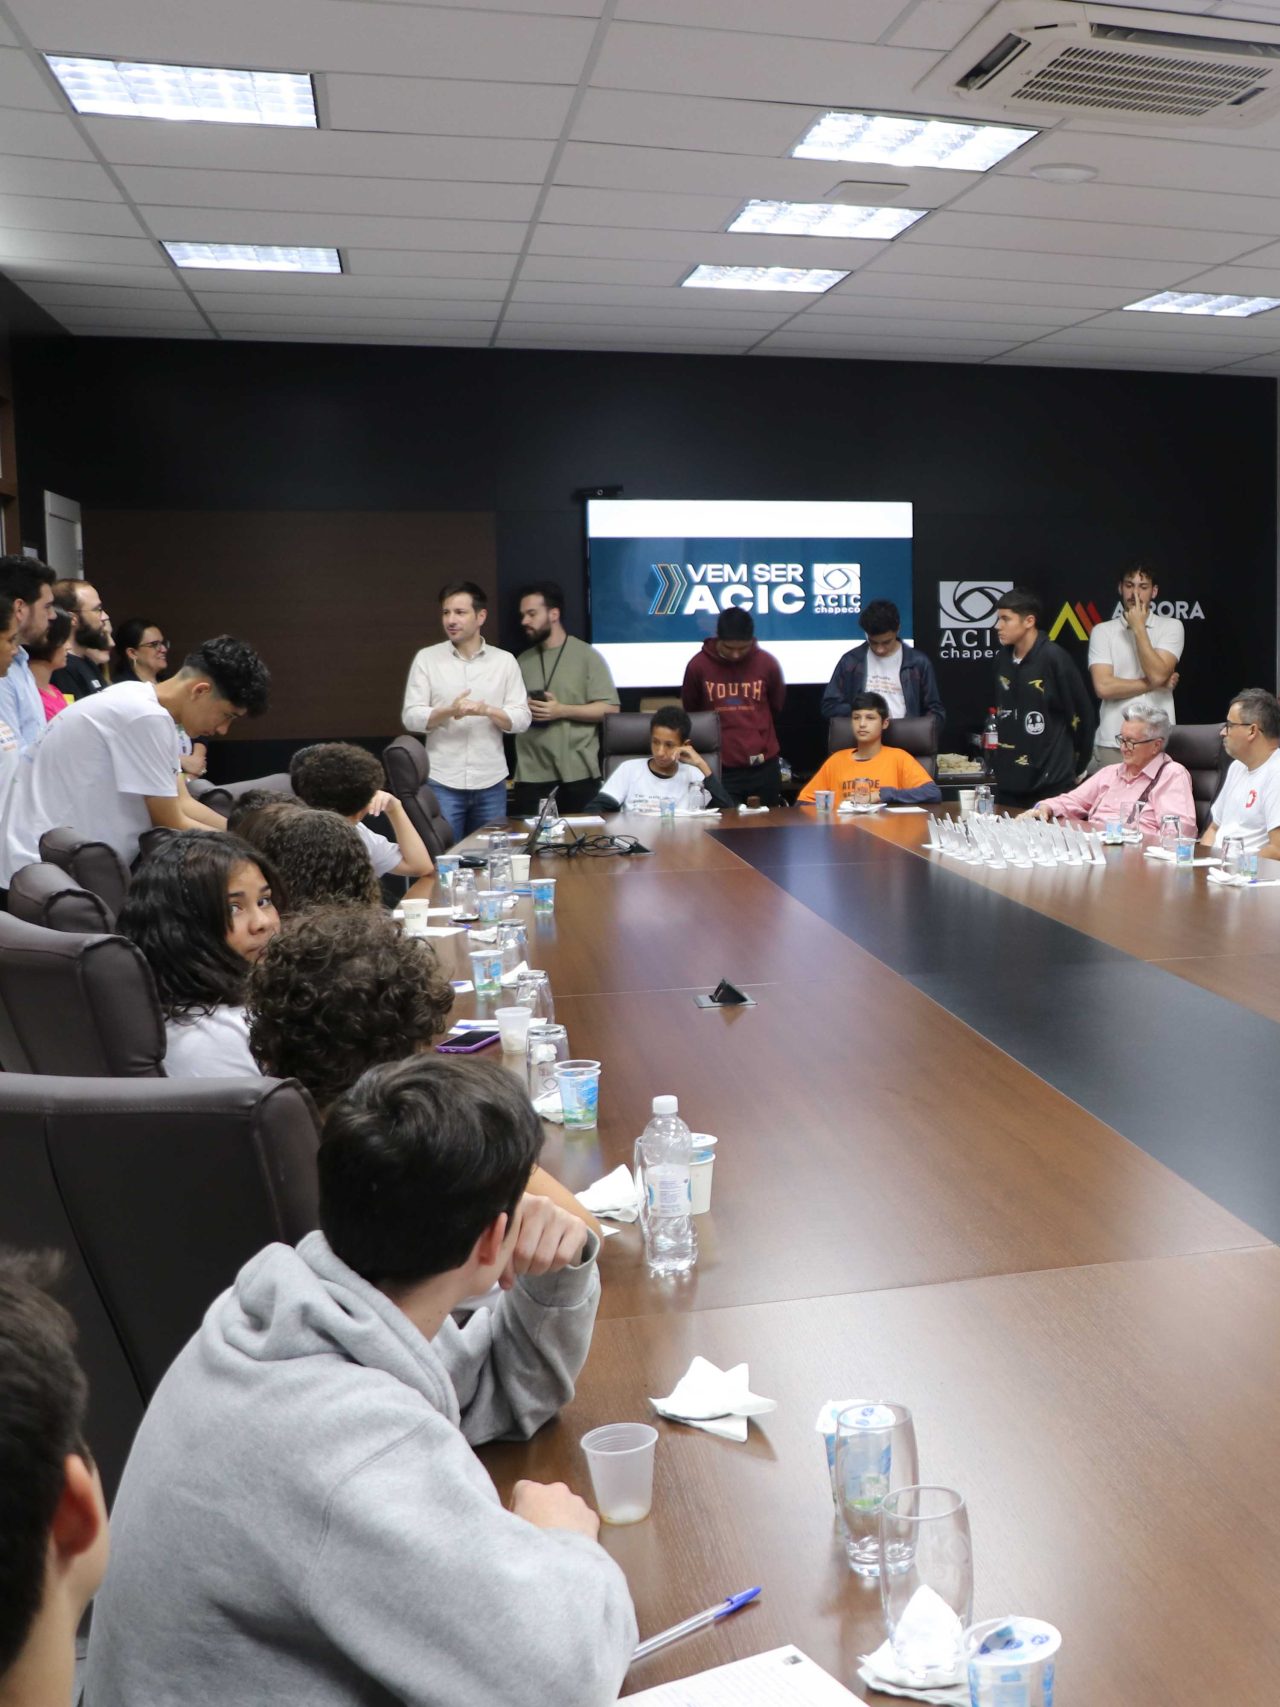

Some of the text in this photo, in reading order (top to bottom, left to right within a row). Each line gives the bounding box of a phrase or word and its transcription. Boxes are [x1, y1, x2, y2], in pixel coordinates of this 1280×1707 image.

[687, 563, 804, 583] VEM SER
[683, 584, 806, 615] ACIC
[814, 595, 861, 606] ACIC
[940, 629, 991, 647] ACI
[940, 648, 1000, 660] chape
[706, 680, 762, 701] YOUTH
